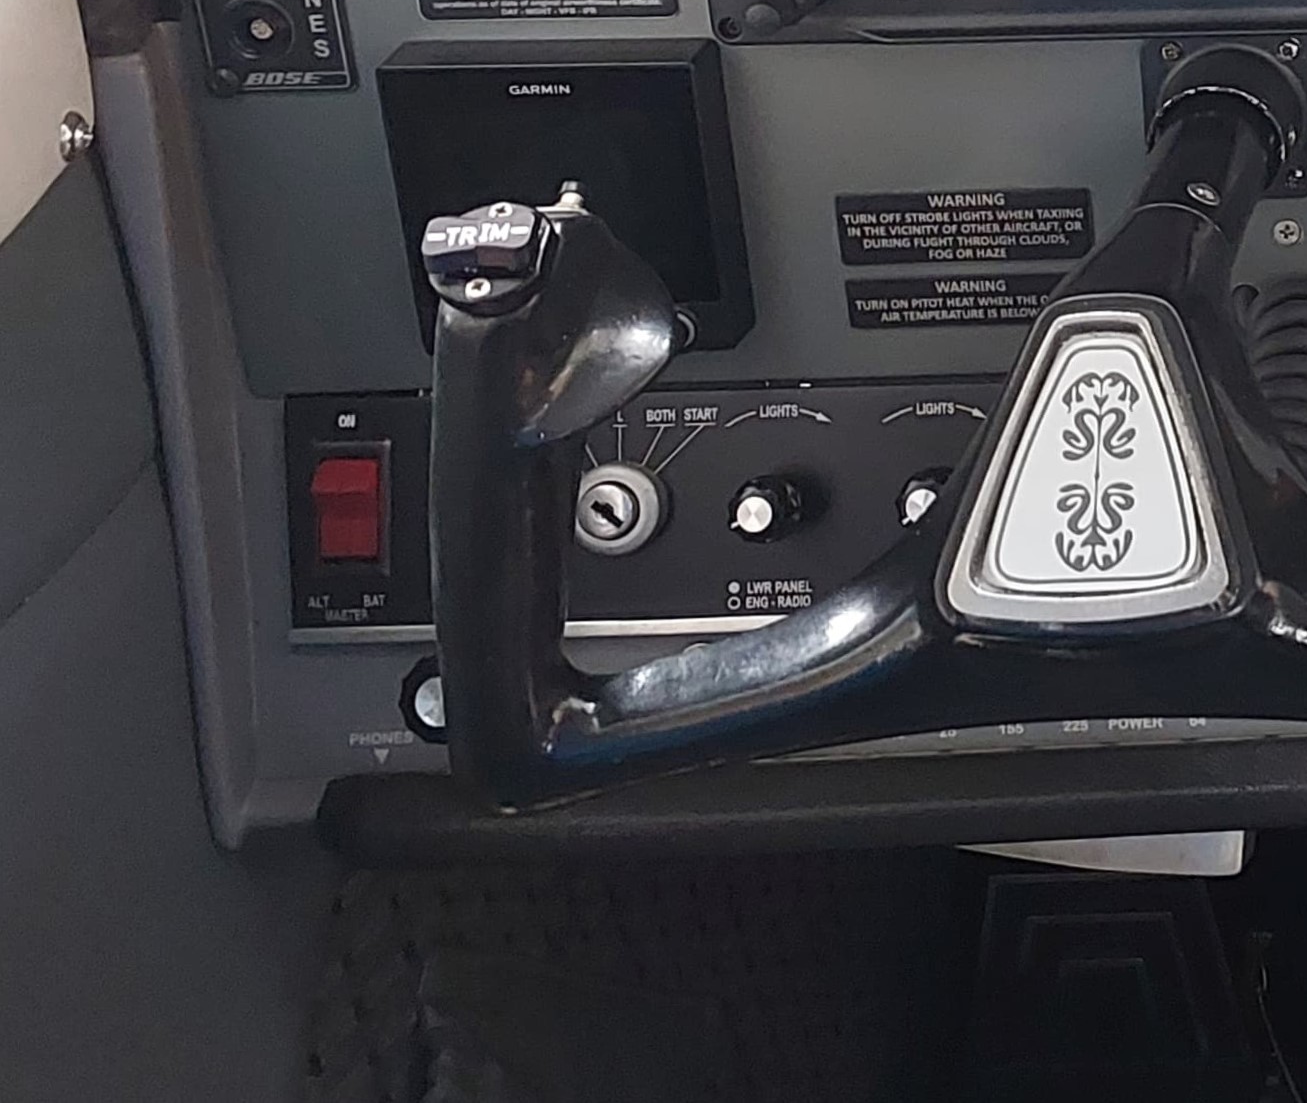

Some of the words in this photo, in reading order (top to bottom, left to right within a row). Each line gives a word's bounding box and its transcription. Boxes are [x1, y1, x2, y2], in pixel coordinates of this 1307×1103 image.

[244, 72, 322, 86] BOSE
[509, 84, 570, 95] GARMIN
[927, 194, 1005, 207] WARNING
[843, 214, 876, 224] TURN
[880, 214, 902, 223] OFF
[905, 213, 949, 222] STROBE
[953, 212, 994, 222] LIGHTS
[998, 210, 1034, 220] WHEN
[445, 222, 510, 246] TRIM
[935, 281, 1006, 292] WARNING
[684, 408, 718, 421] START
[760, 405, 799, 418] LIGHTS
[915, 401, 955, 416] LIGHTS
[338, 415, 356, 428] ON
[646, 409, 676, 422] BOTH
[746, 581, 772, 594] LWR
[775, 580, 812, 593] PANEL
[308, 596, 329, 608] ALT
[363, 595, 386, 607] BAT
[350, 733, 413, 745] PHONES
